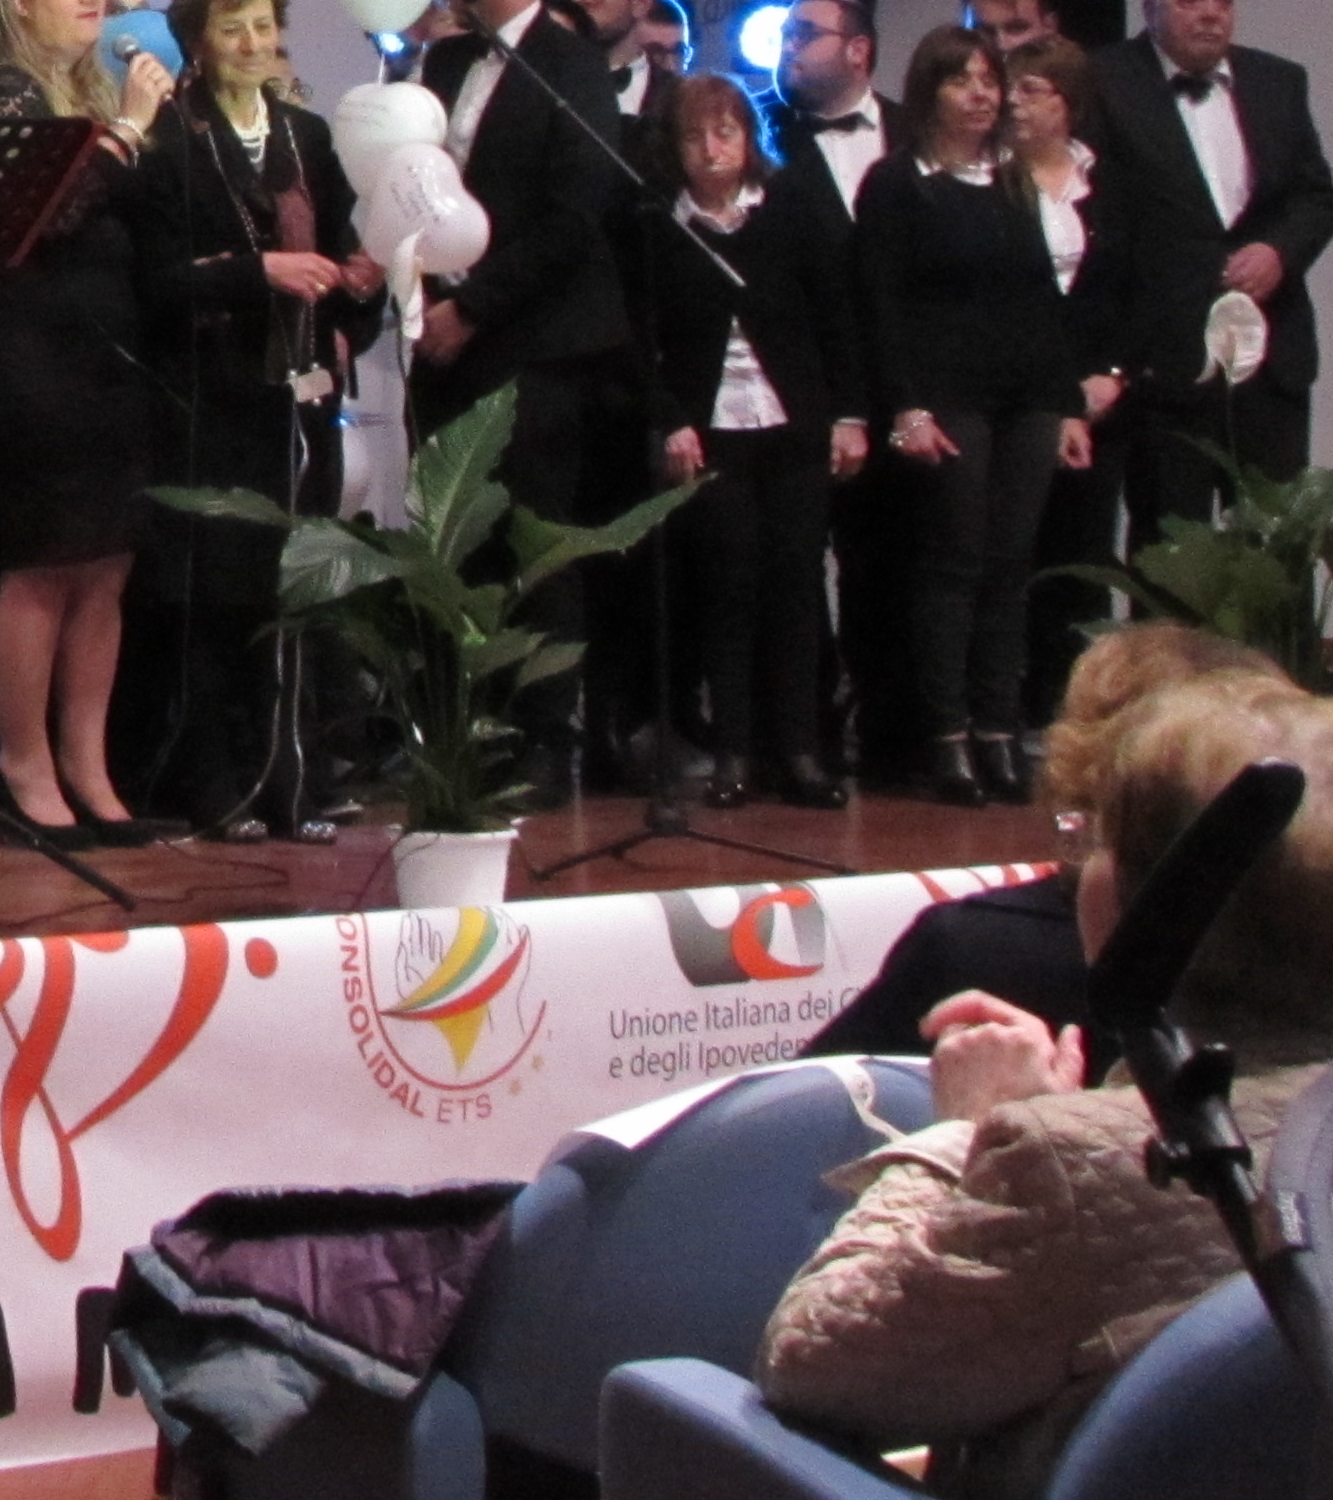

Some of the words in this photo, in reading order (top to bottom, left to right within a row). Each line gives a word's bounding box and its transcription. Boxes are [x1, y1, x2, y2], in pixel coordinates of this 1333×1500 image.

[335, 912, 425, 1120] ONSOLIDAL
[435, 1092, 494, 1125] ETS
[608, 1007, 698, 1041] Unione
[704, 996, 791, 1031] Italiana
[797, 988, 833, 1020] dei
[608, 1059, 624, 1080] e
[630, 1045, 690, 1082] degli
